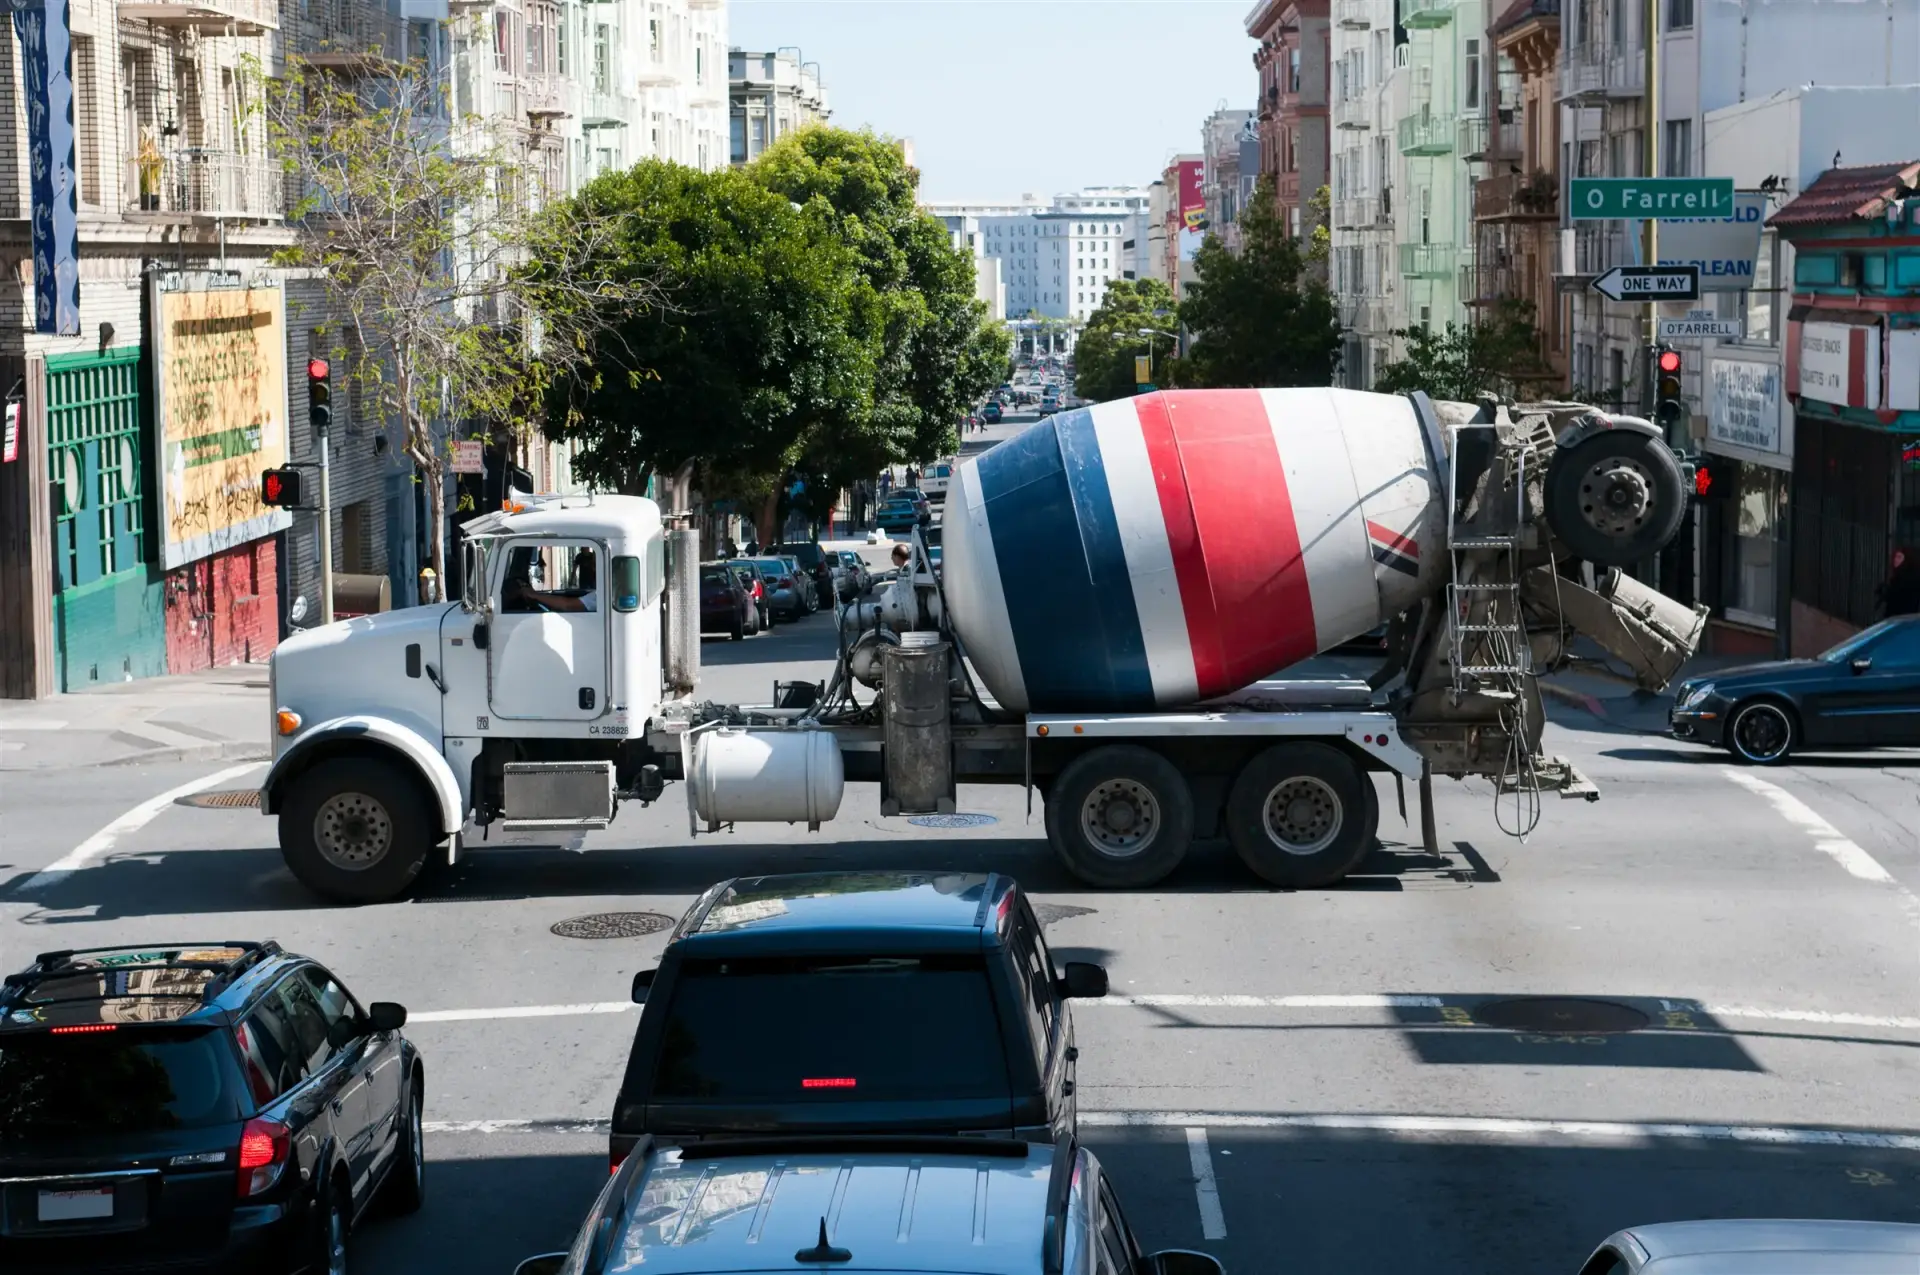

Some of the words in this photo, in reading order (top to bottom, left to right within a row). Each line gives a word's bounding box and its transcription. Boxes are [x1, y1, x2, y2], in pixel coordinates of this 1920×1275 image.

[1587, 188, 1604, 208] O
[1622, 188, 1718, 208] Farrell
[1623, 277, 1651, 291] ONE
[1657, 277, 1687, 290] WAY
[1667, 323, 1732, 334] O'FARRELL
[589, 725, 600, 734] CA
